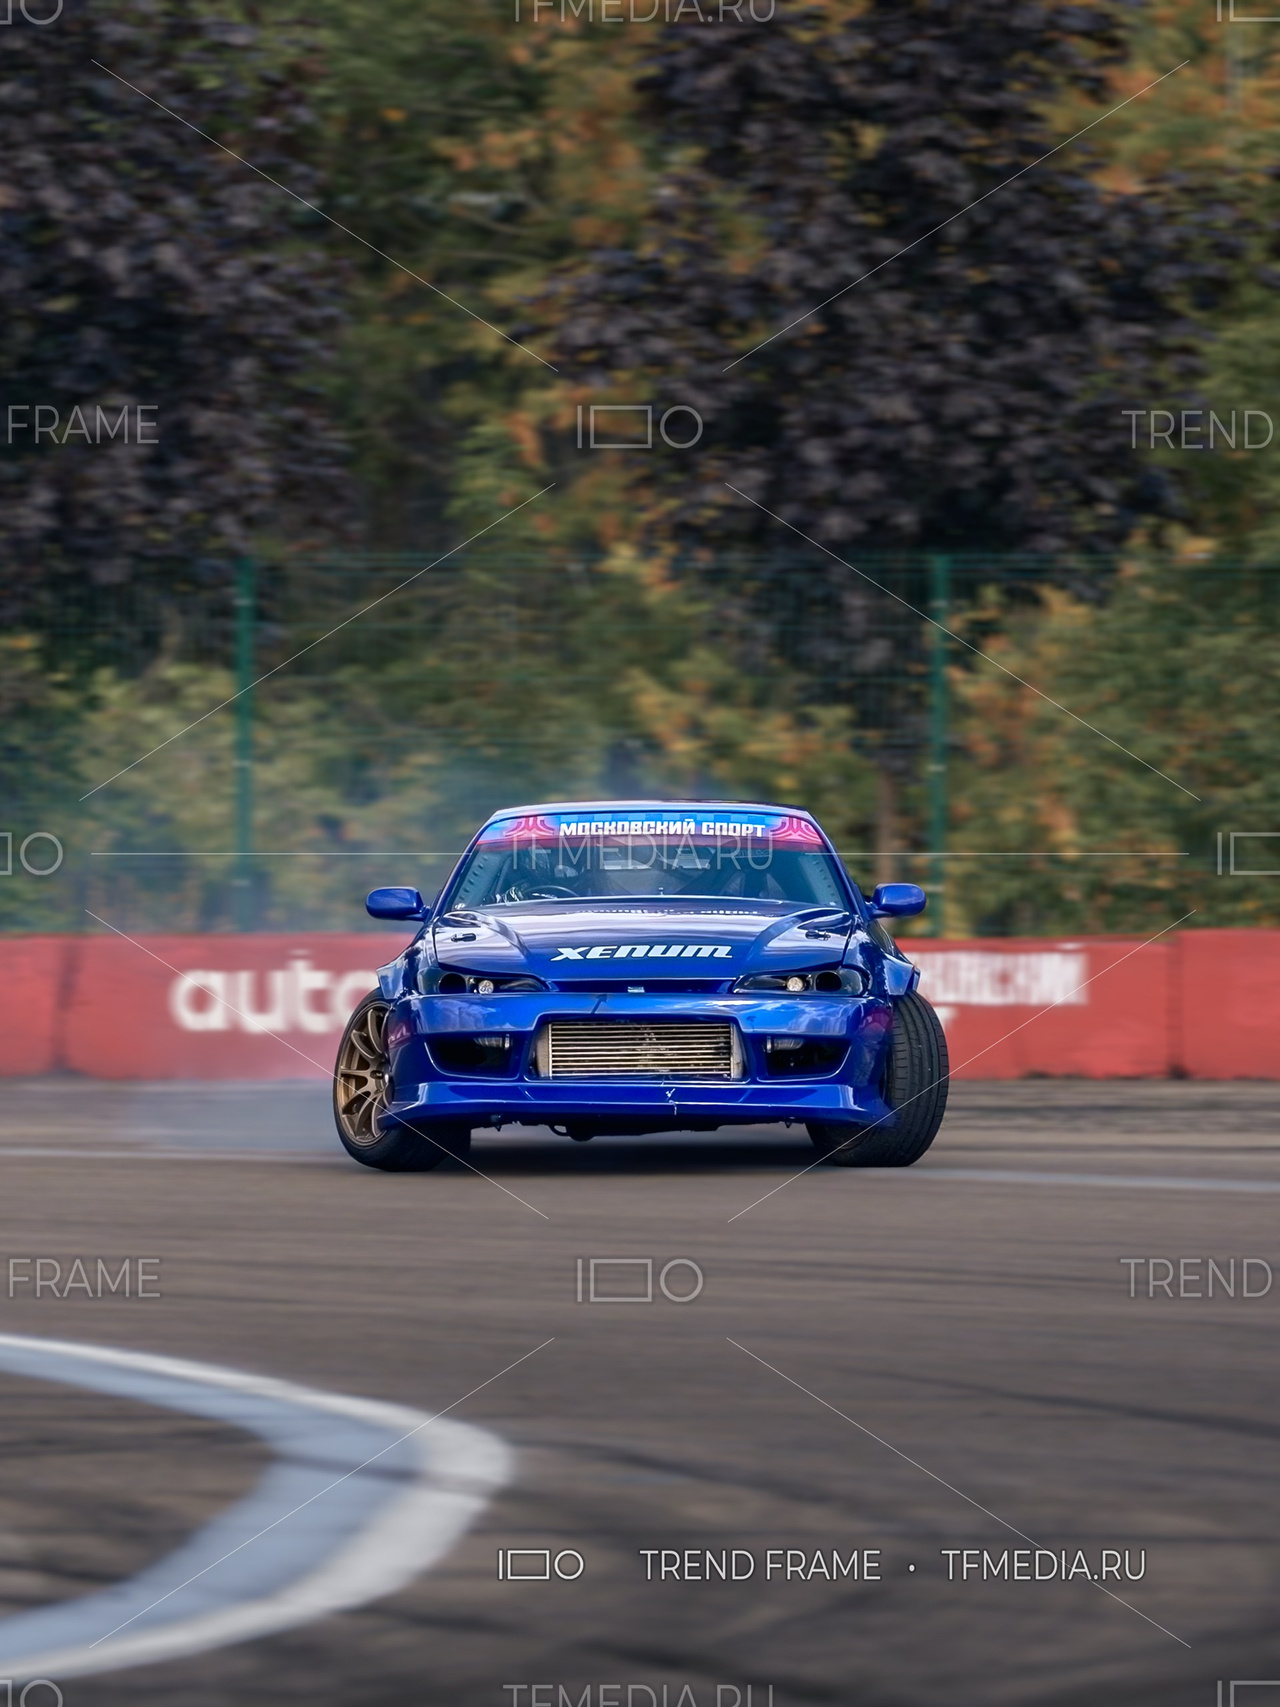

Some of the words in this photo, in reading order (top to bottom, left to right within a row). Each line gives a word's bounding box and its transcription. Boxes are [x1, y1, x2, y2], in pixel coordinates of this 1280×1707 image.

[559, 819, 696, 837] МОСКОВСКИЙ
[701, 822, 766, 838] СПОРТ
[550, 945, 733, 961] XENUM
